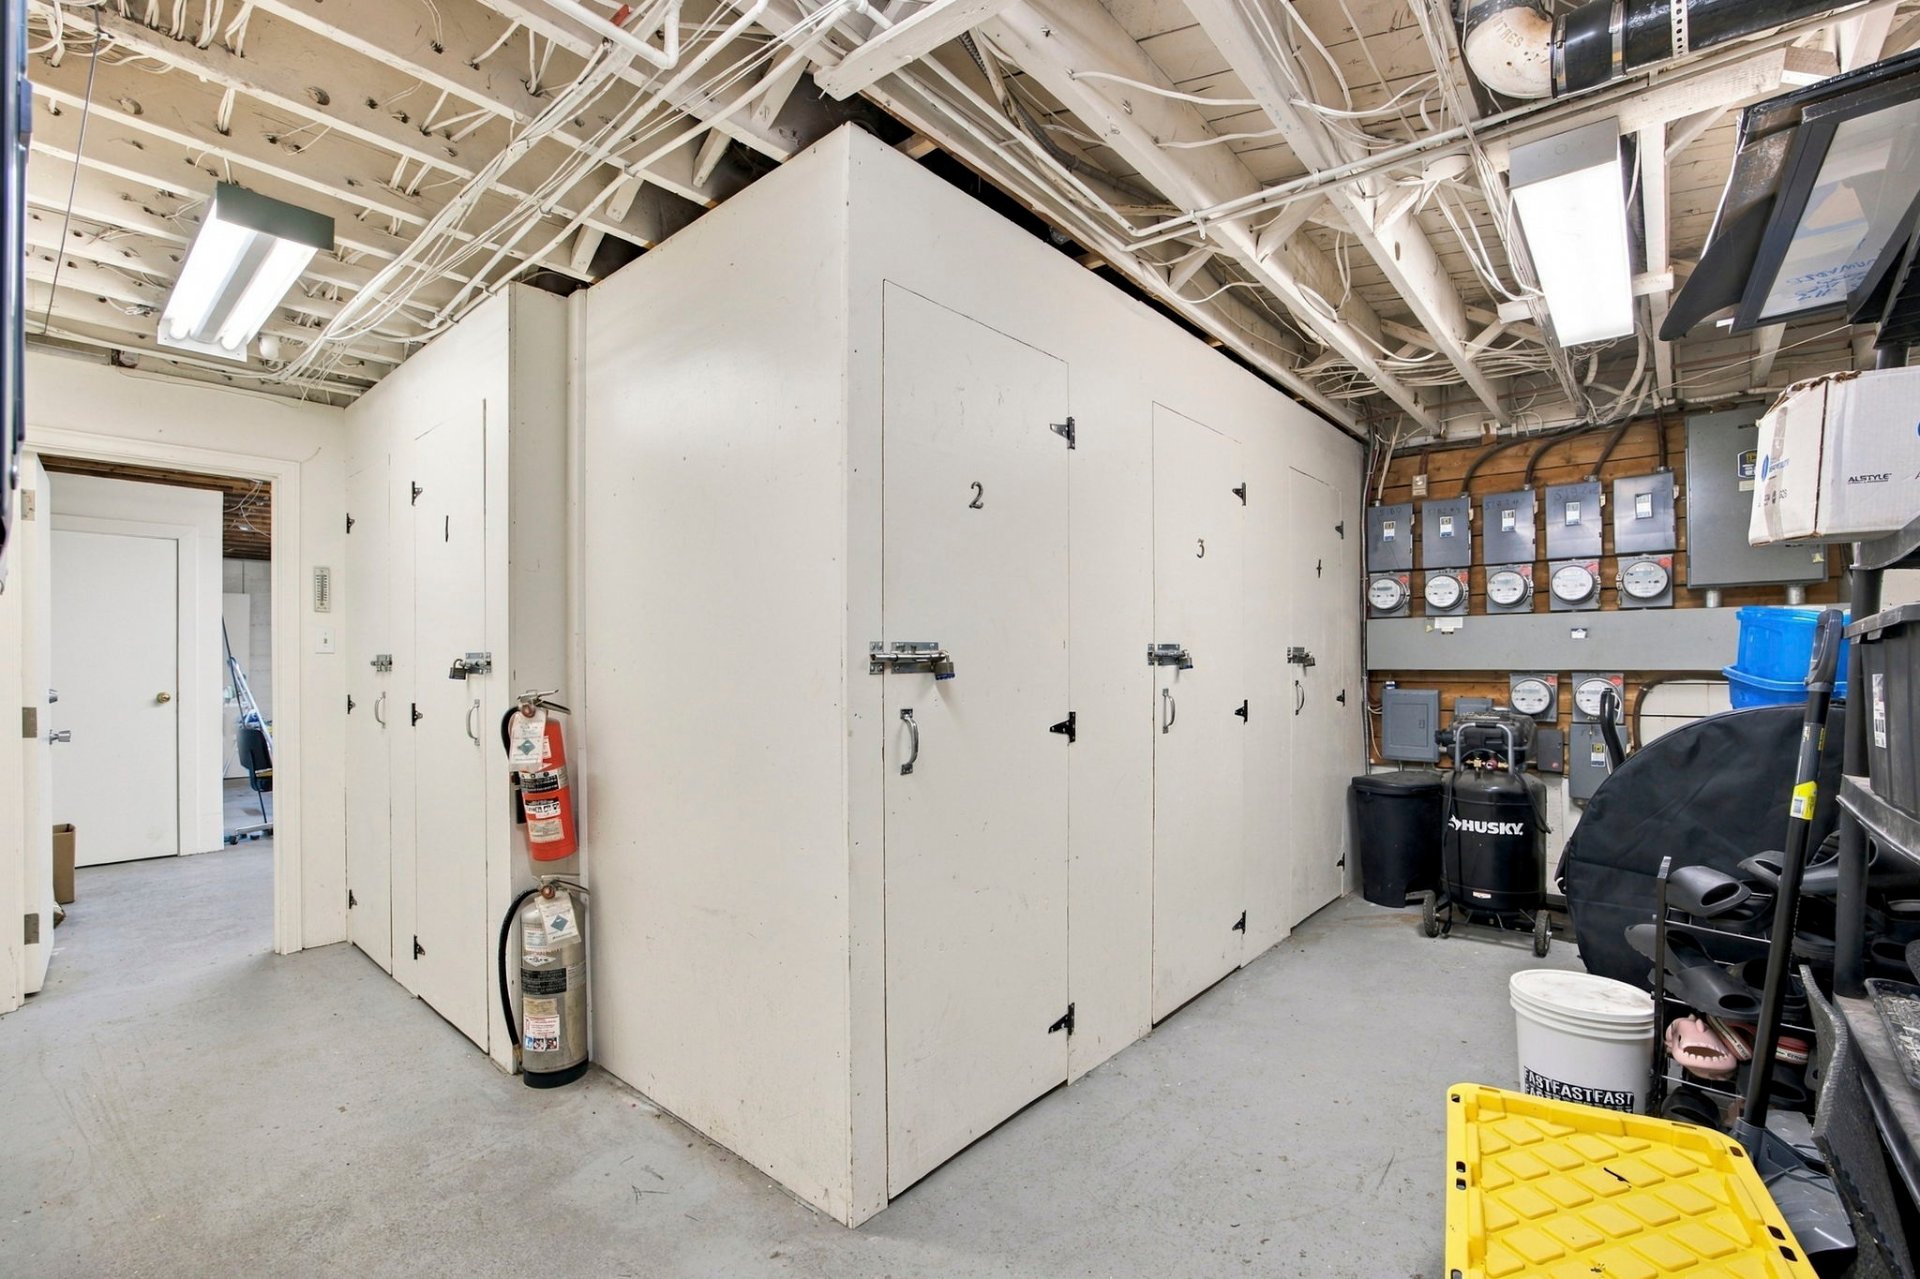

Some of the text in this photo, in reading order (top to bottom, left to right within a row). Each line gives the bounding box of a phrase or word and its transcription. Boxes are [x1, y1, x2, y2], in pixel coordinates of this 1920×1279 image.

[1848, 473, 1889, 483] ALSTYLE
[969, 481, 984, 509] 2
[445, 515, 449, 542] 1
[1196, 538, 1205, 559] 3
[1461, 819, 1523, 835] HUSKY
